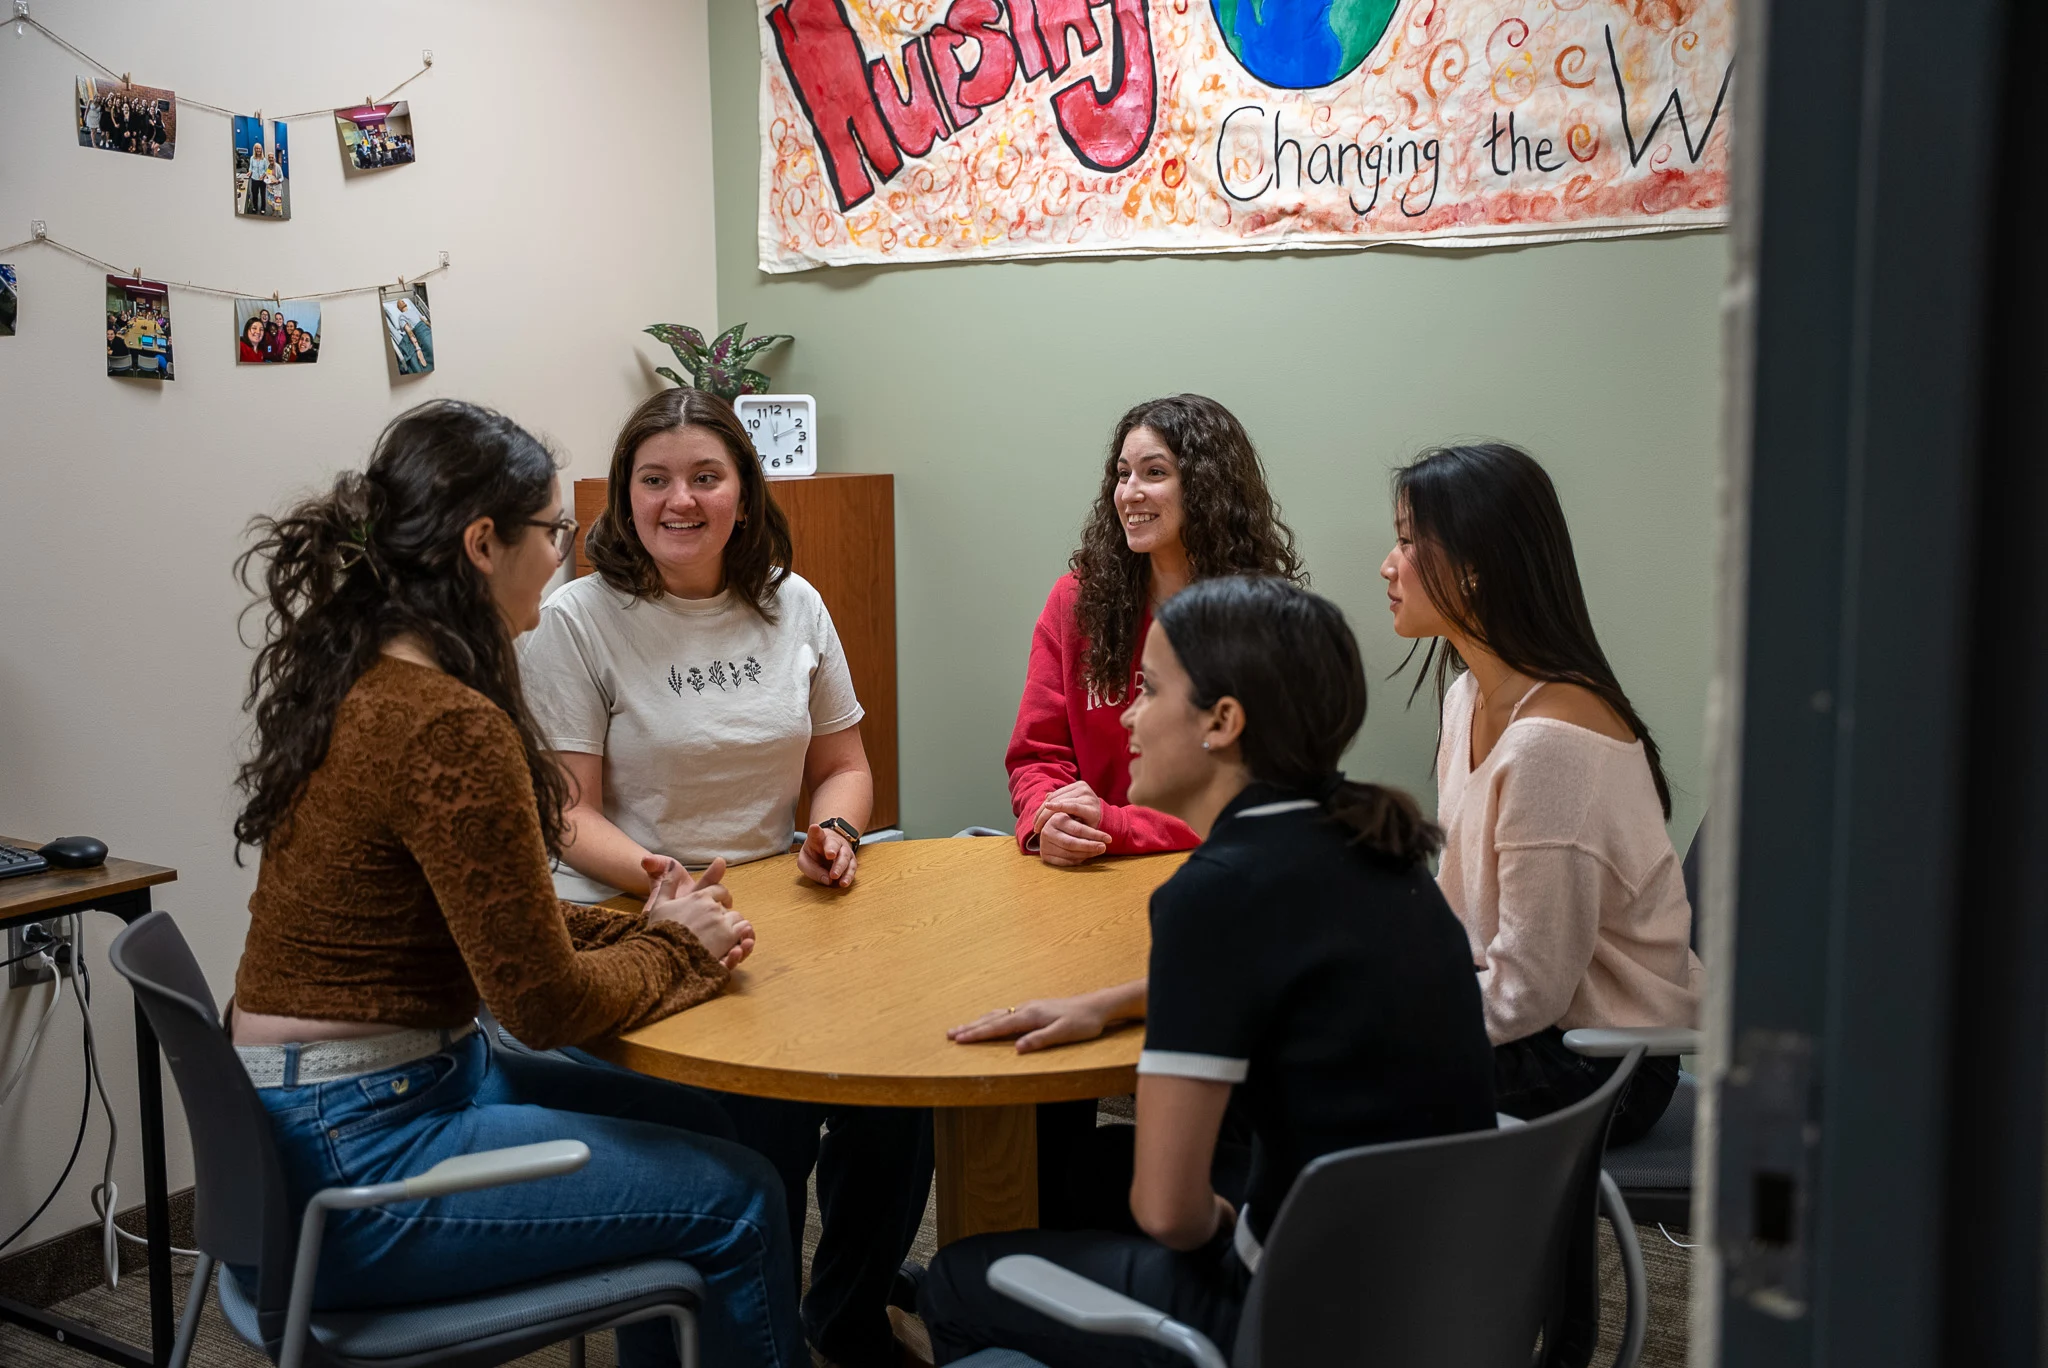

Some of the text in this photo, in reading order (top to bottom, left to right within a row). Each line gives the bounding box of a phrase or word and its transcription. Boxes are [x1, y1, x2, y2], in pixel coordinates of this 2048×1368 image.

[1217, 105, 1440, 217] Changing
[1483, 111, 1565, 176] the
[757, 408, 767, 418] 11
[769, 404, 782, 415] 12
[786, 408, 791, 418] 1
[747, 419, 760, 429] 10
[795, 418, 803, 428] 2
[798, 431, 807, 441] 3
[794, 445, 804, 454] 4
[759, 454, 767, 462] 7
[771, 457, 780, 467] 6
[785, 454, 793, 464] 5
